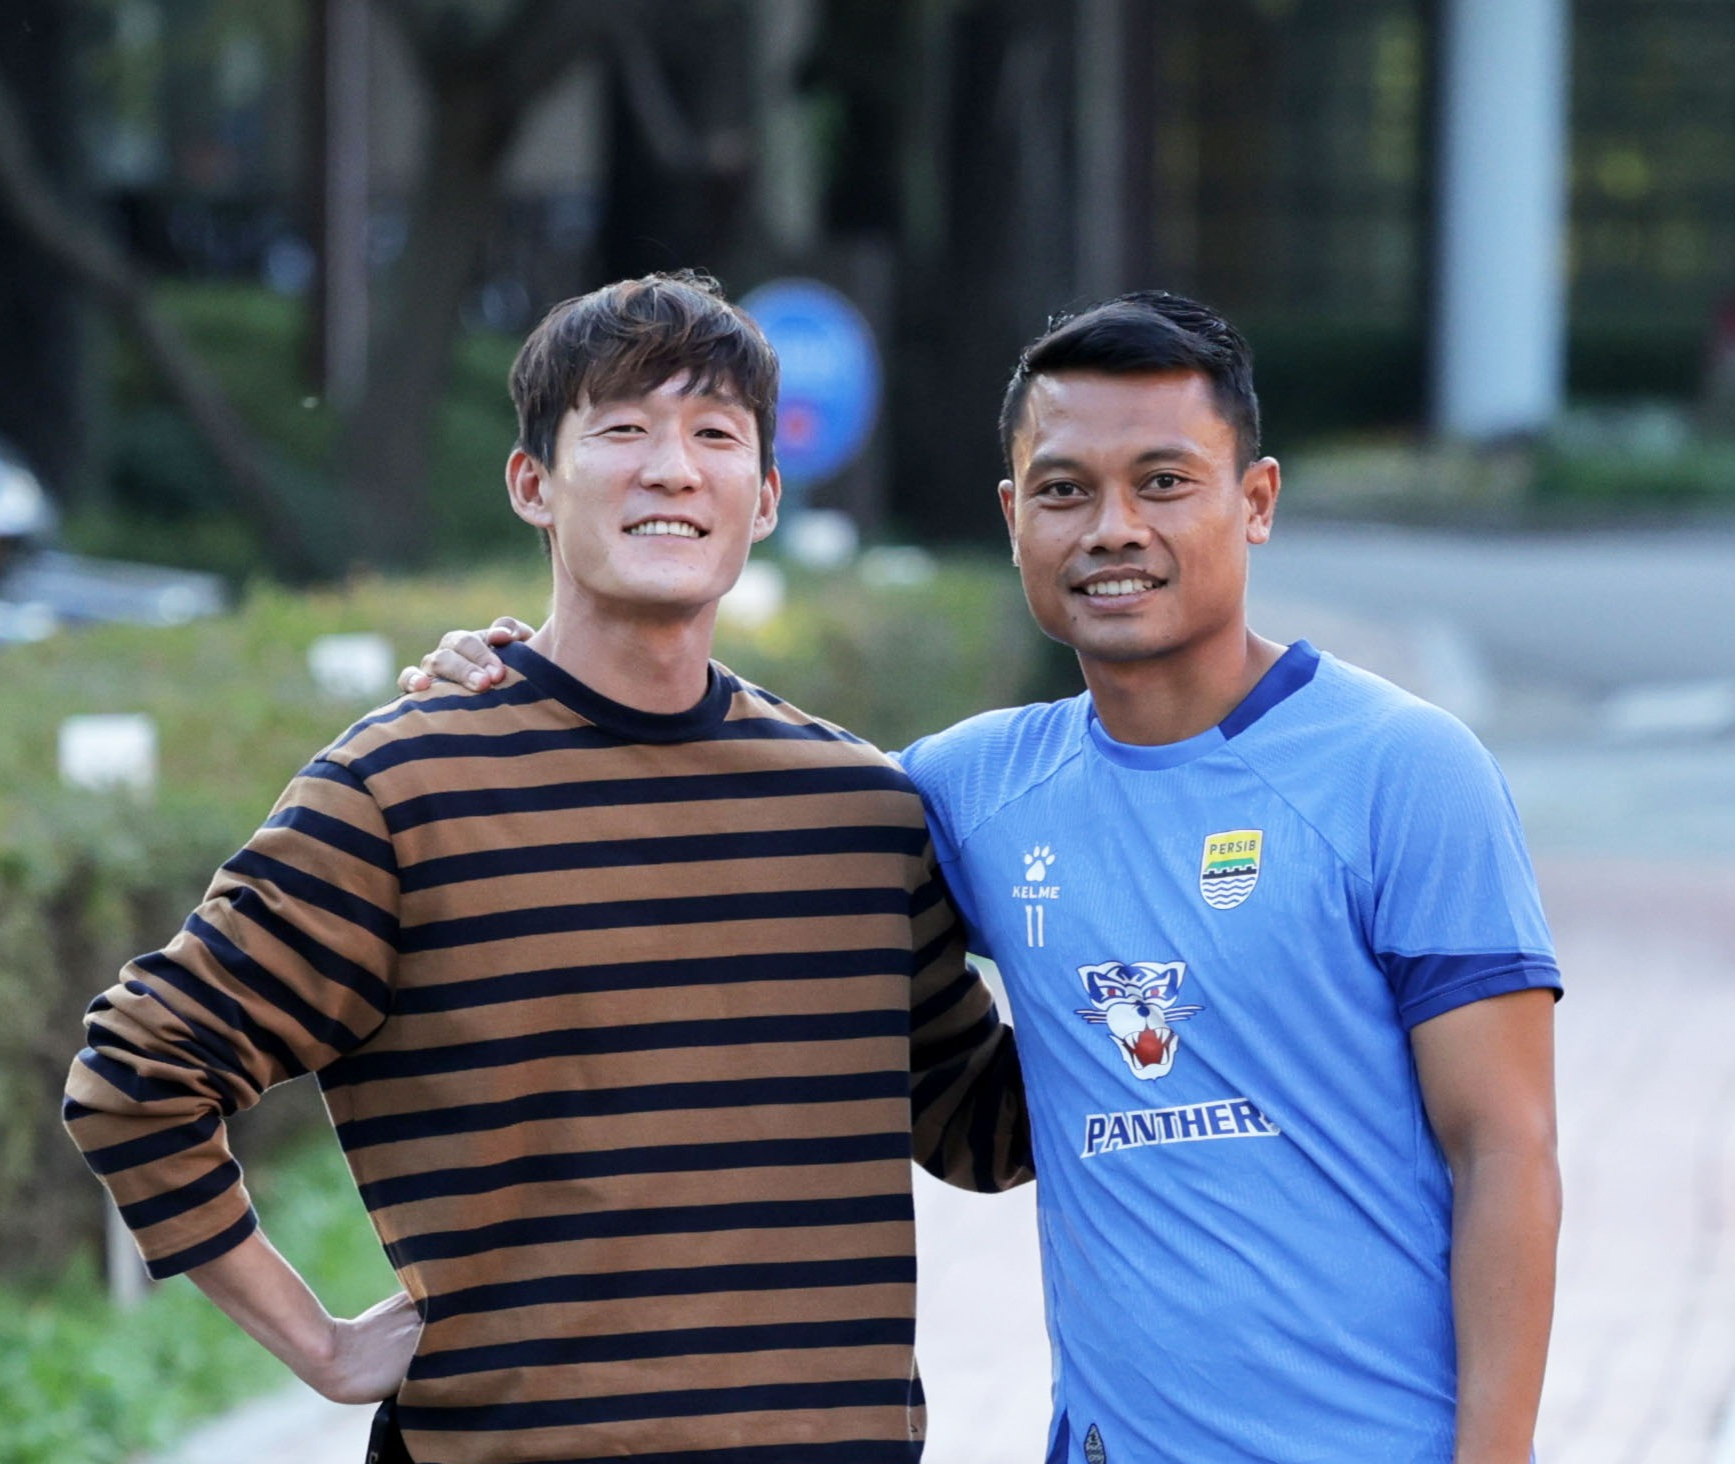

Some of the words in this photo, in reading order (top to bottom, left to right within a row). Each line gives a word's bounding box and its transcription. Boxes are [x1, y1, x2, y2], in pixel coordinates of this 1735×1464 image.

[1209, 840, 1256, 855] PERSIB
[1012, 885, 1061, 899] KELME
[1025, 905, 1044, 948] 11
[1081, 1098, 1278, 1157] PANTHER
